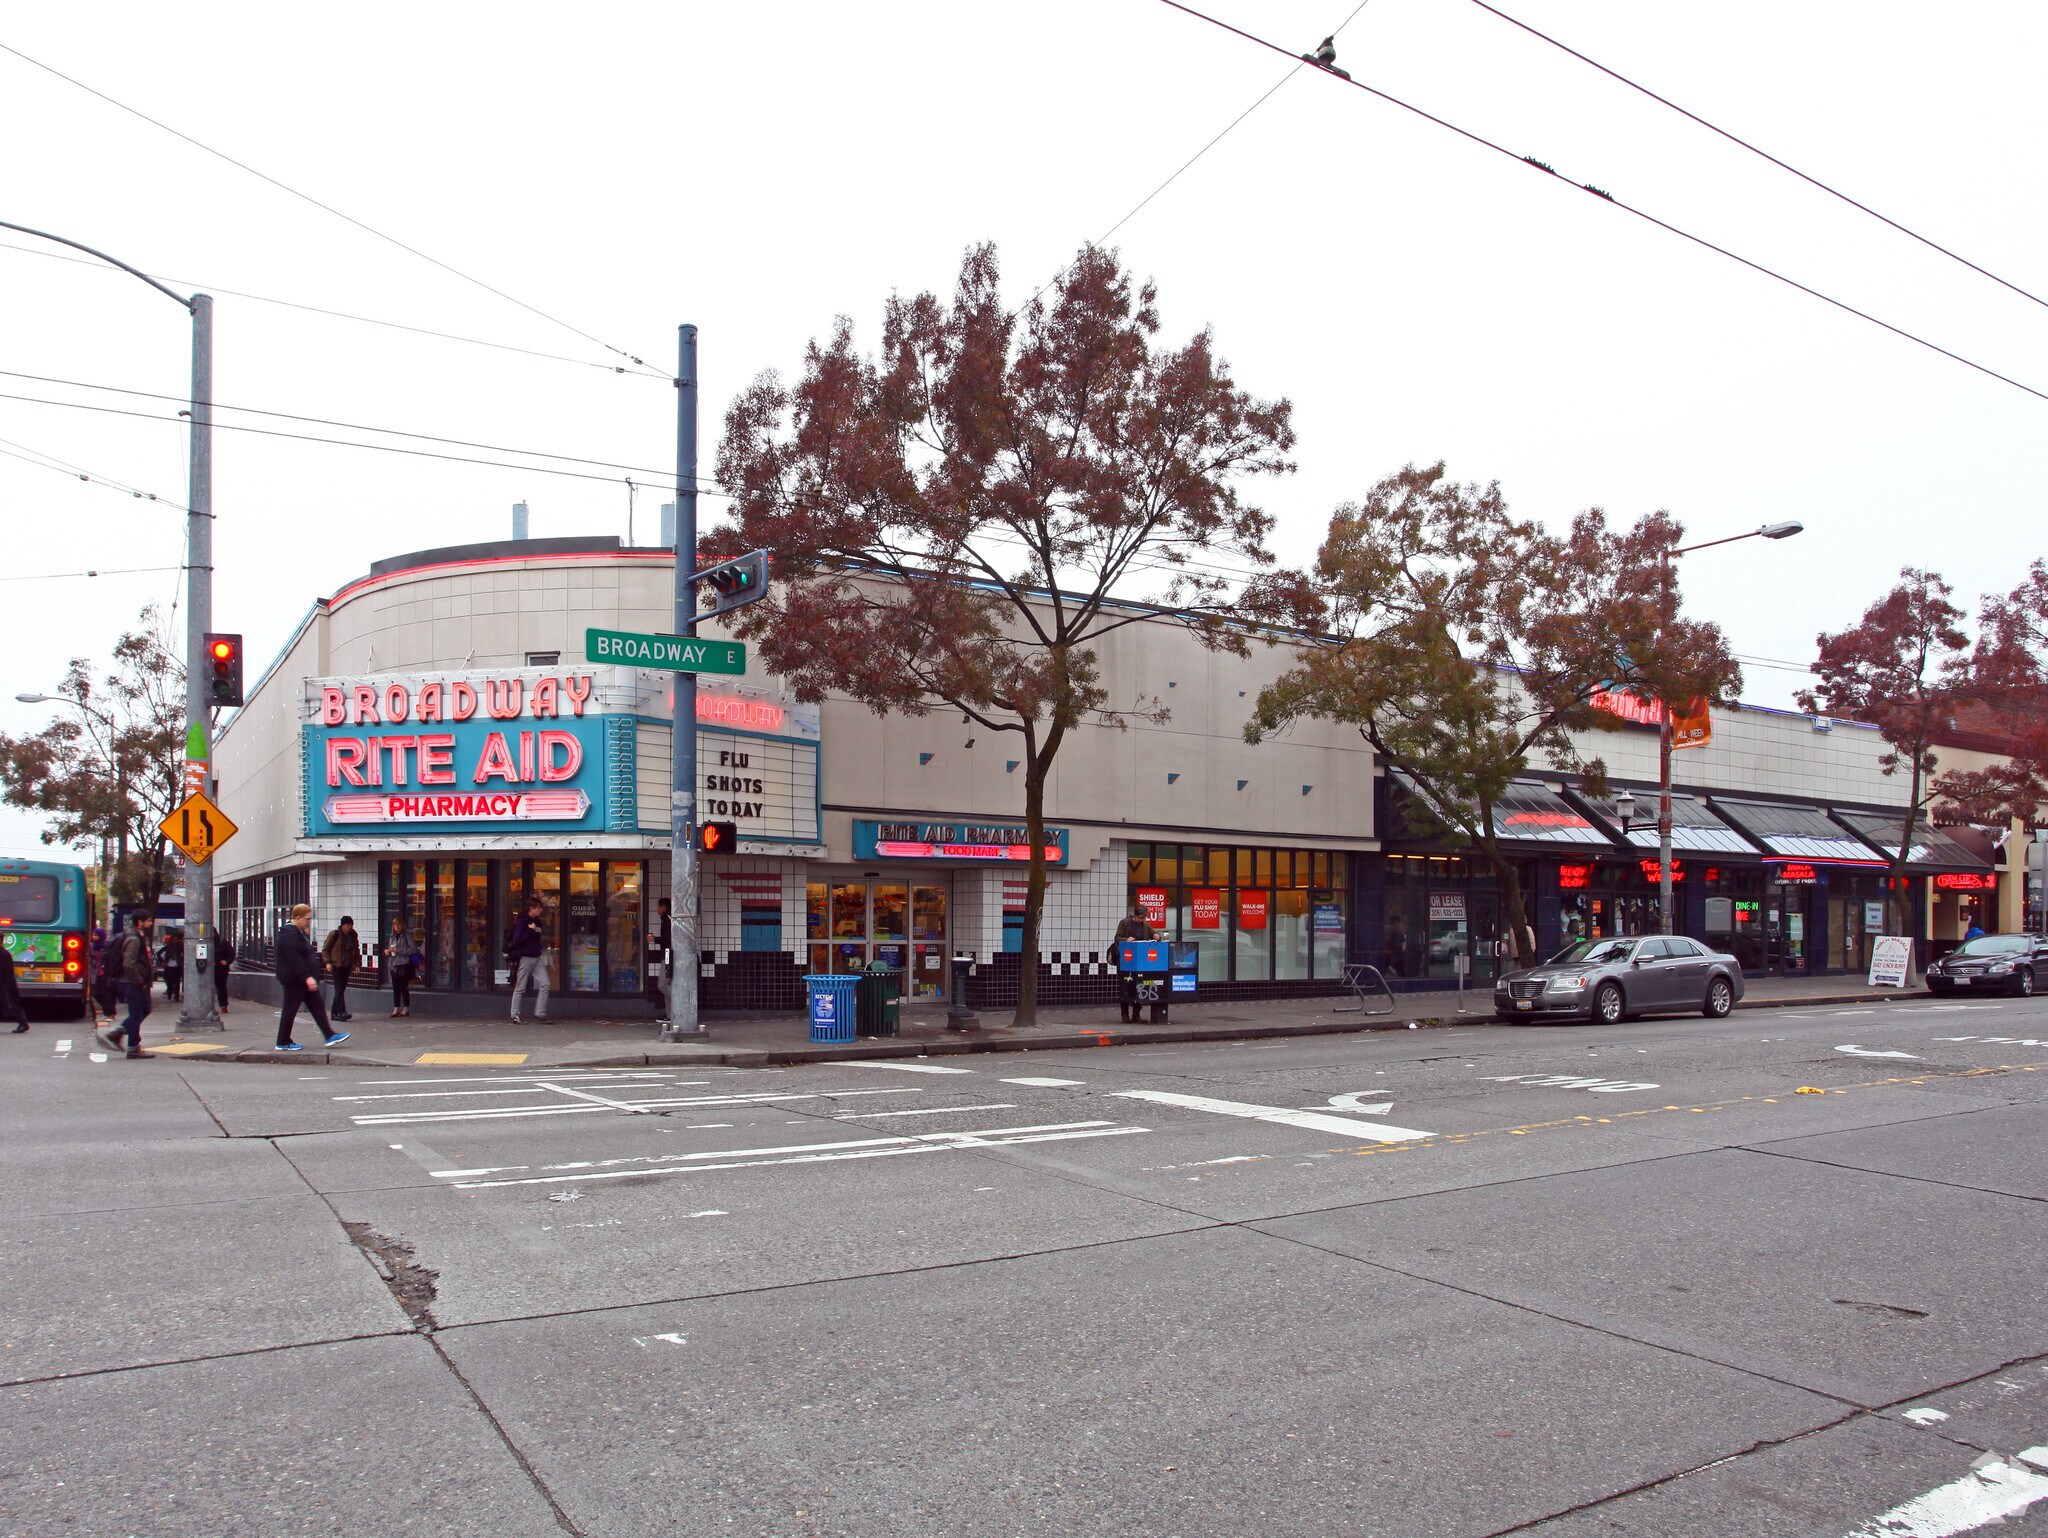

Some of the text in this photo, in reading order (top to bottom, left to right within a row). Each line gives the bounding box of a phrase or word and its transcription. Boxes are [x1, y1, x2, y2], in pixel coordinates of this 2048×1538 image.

[597, 636, 736, 664] BROADWAY E
[322, 675, 592, 727] BROADWAY
[695, 696, 783, 727] OADWAY
[326, 729, 584, 787] RITE AID
[720, 751, 749, 768] FLU
[707, 775, 763, 794] SHOTS
[389, 795, 523, 817] PHARMACY
[707, 799, 763, 818] TODAY
[878, 824, 1063, 846] RITE AID PHARMCY
[1640, 860, 1681, 872] TREY
[1647, 871, 1685, 883] WEDY
[1782, 871, 1816, 879] MASALA
[1139, 893, 1165, 902] SHIELD
[1442, 896, 1463, 907] LEASE
[1735, 901, 1759, 911] DINE-IN
[1145, 912, 1158, 922] LU
[1194, 911, 1218, 919] TODAY
